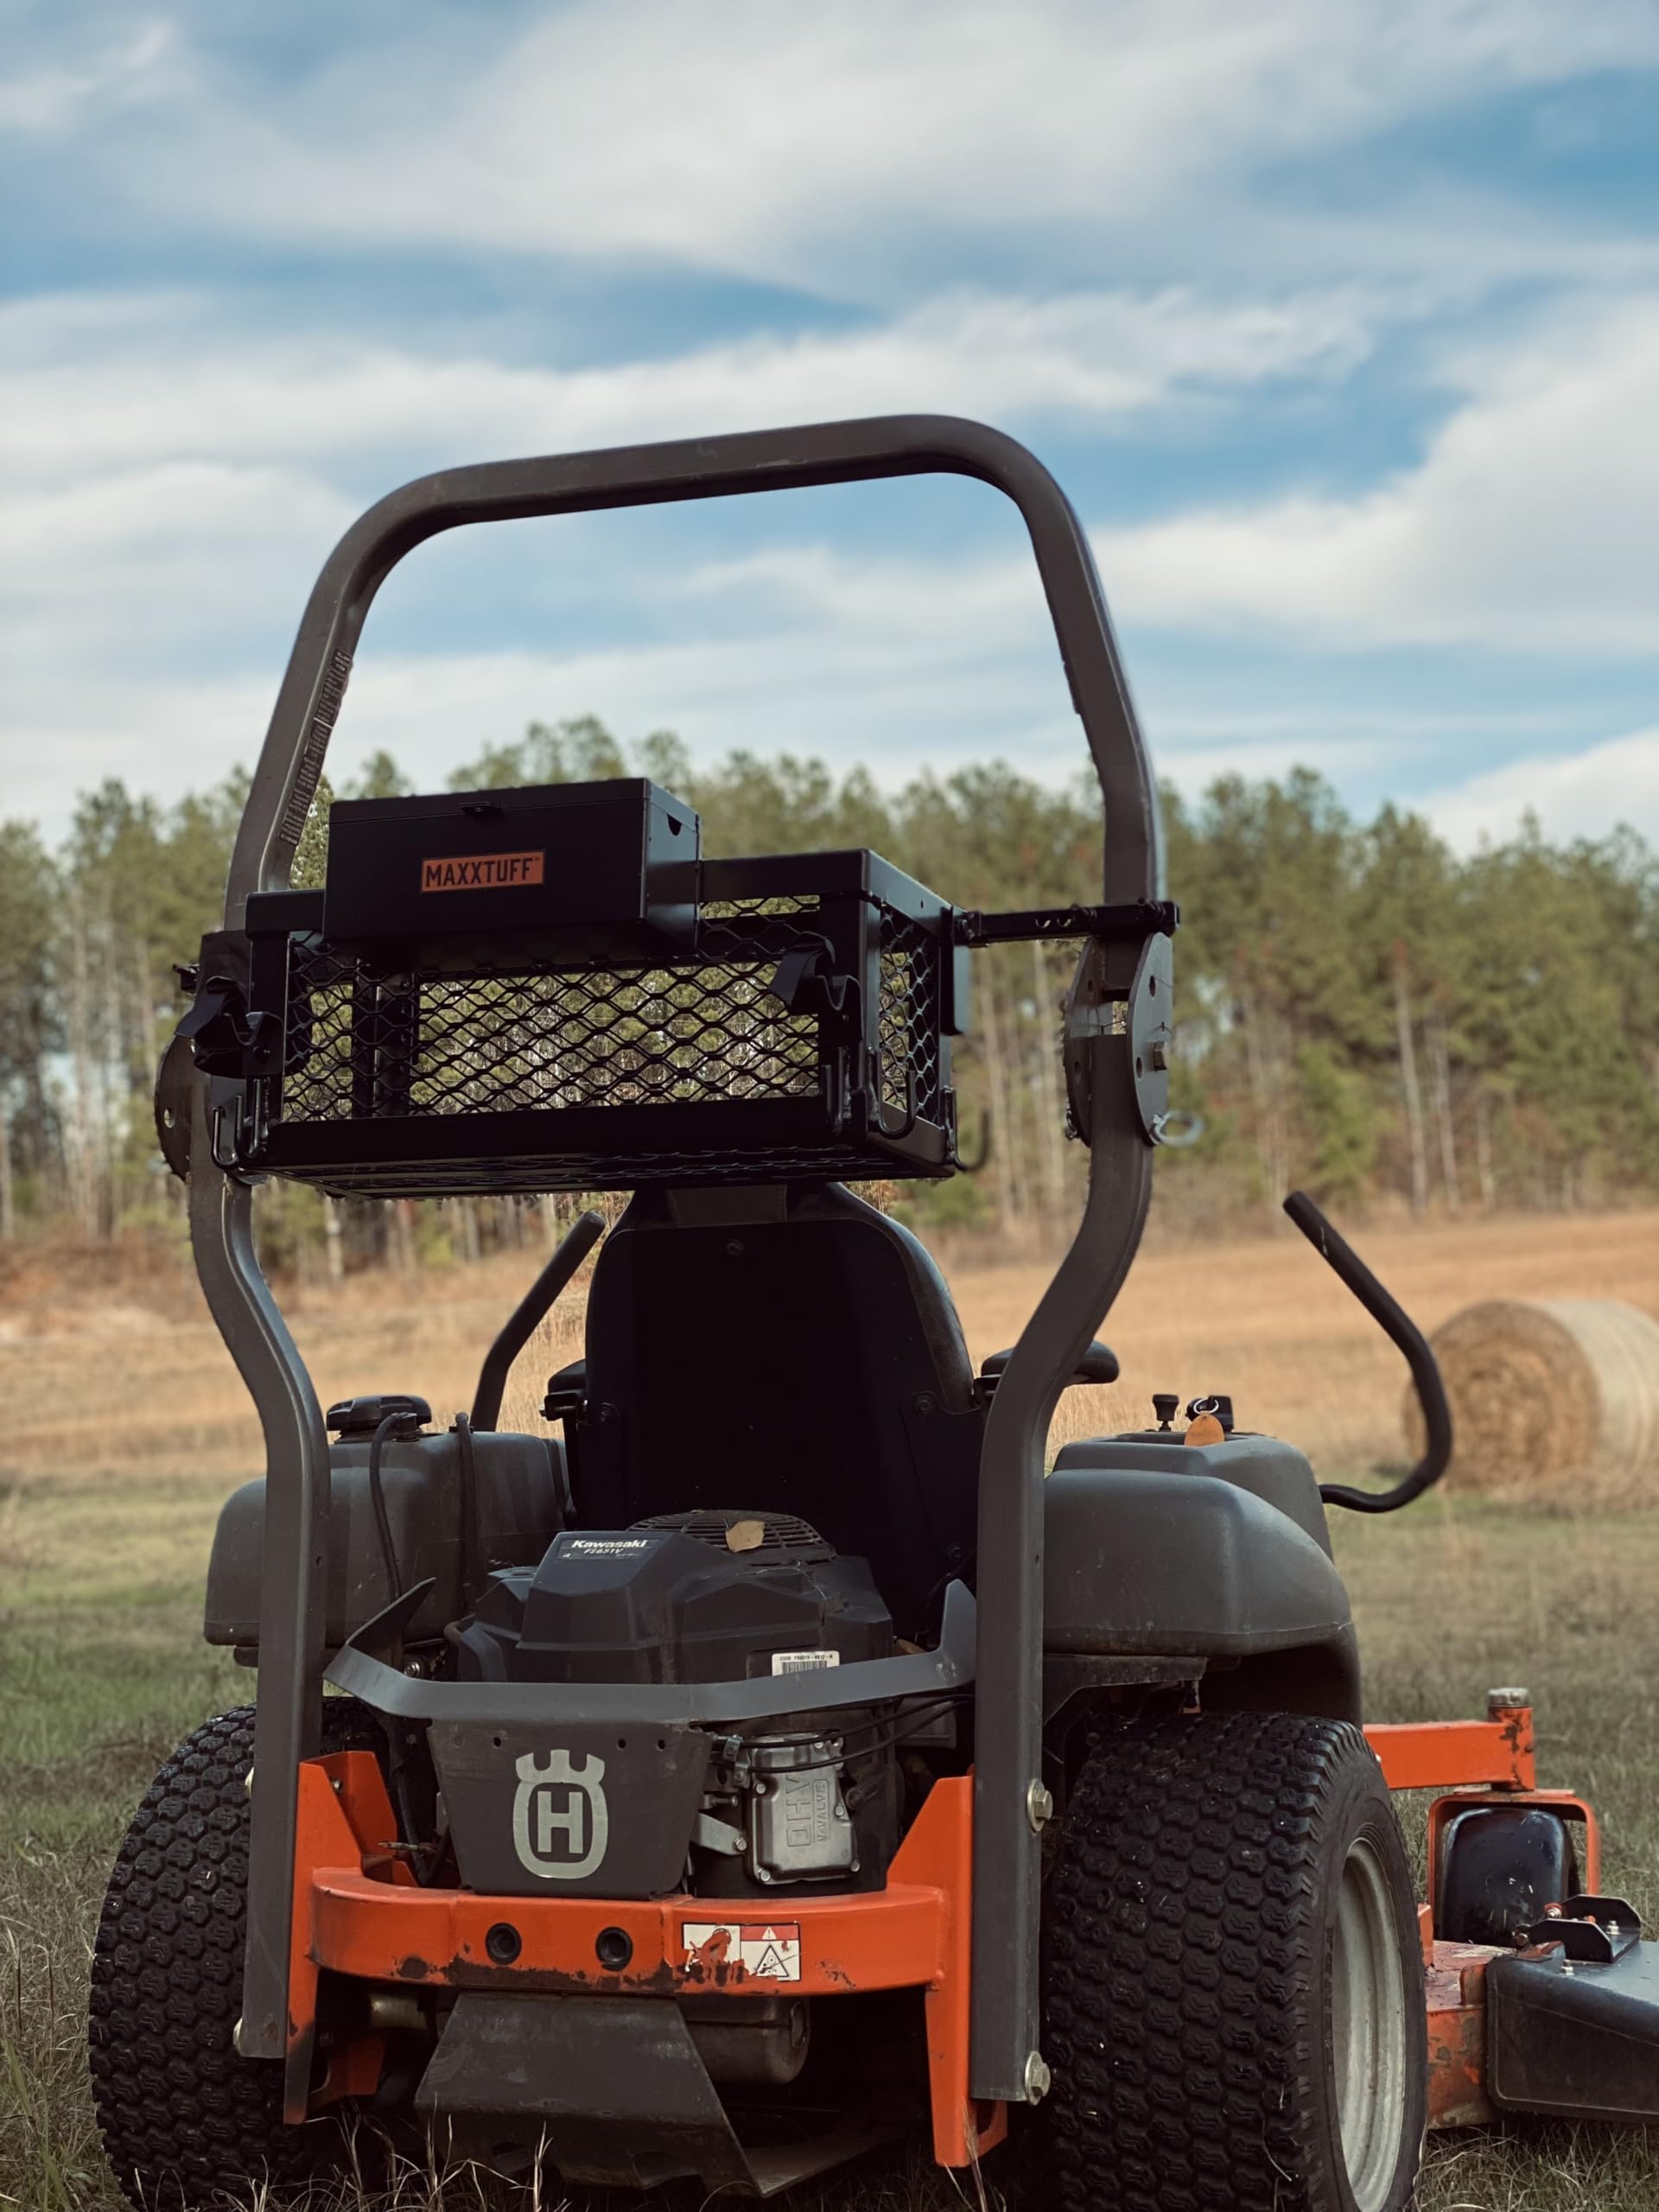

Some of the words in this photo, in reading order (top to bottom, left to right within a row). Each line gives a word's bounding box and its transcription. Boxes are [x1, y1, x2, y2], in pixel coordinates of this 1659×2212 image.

[425, 857, 533, 887] MAXXTUFF
[571, 1540, 648, 1548] Kawasaki
[785, 1774, 811, 1847] OHV
